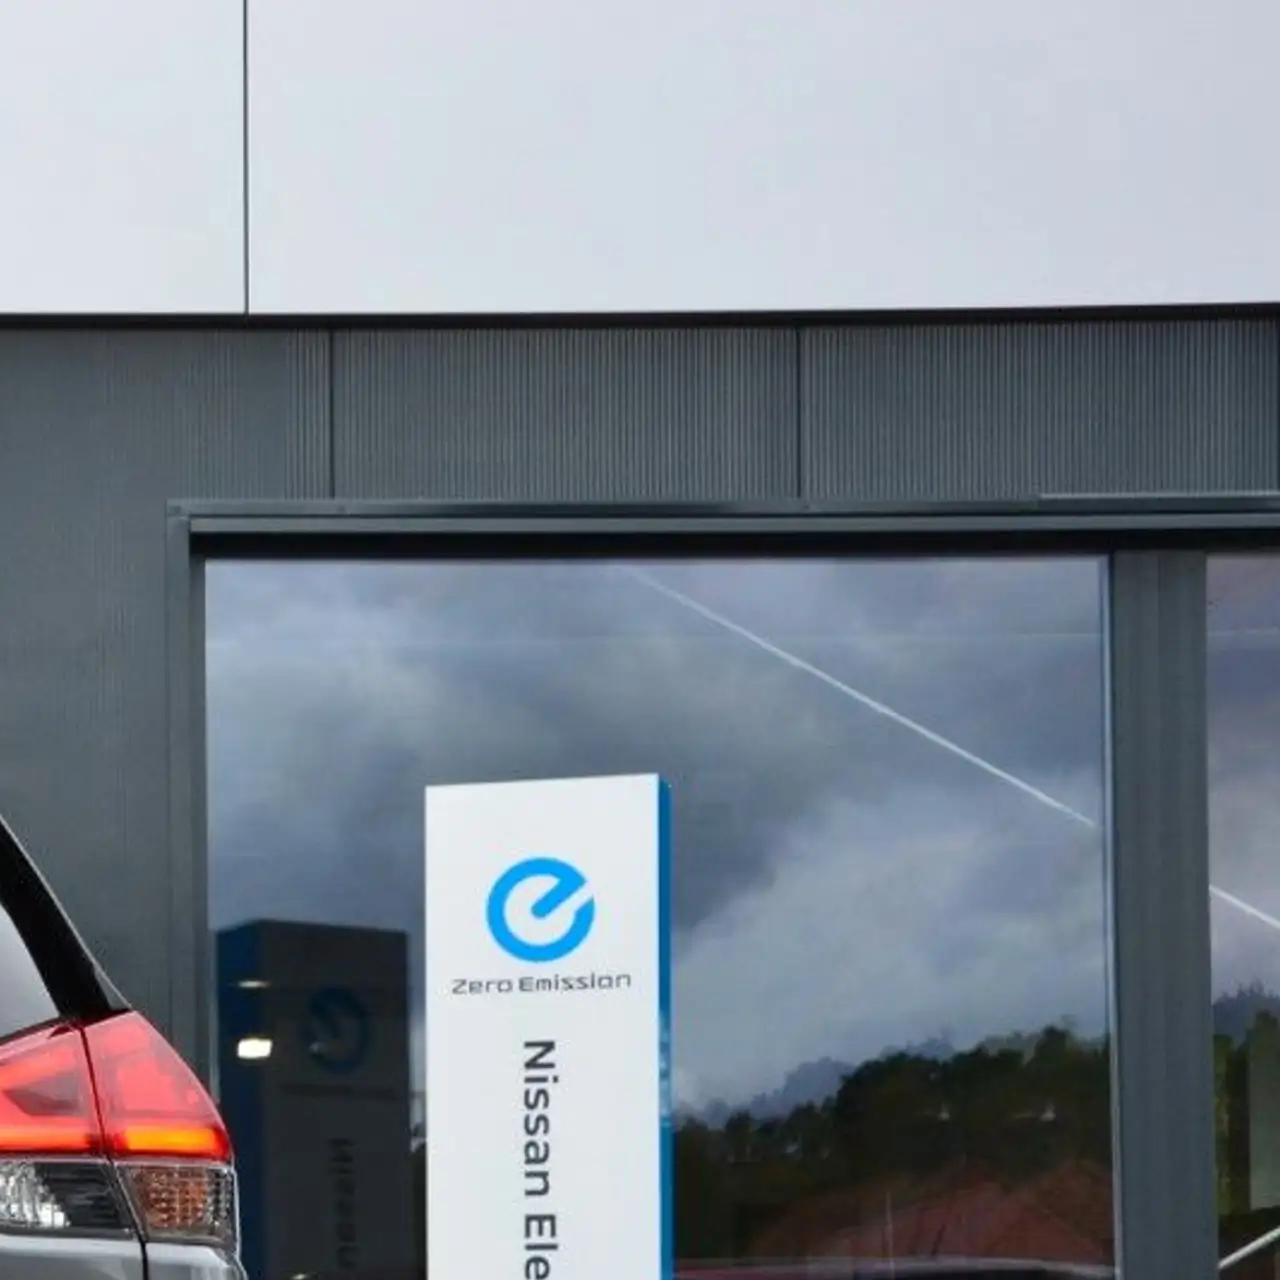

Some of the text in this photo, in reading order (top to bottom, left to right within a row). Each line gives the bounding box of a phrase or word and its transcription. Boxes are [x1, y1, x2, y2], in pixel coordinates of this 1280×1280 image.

[451, 971, 632, 995] Zero Emission
[523, 1040, 559, 1198] Nissan
